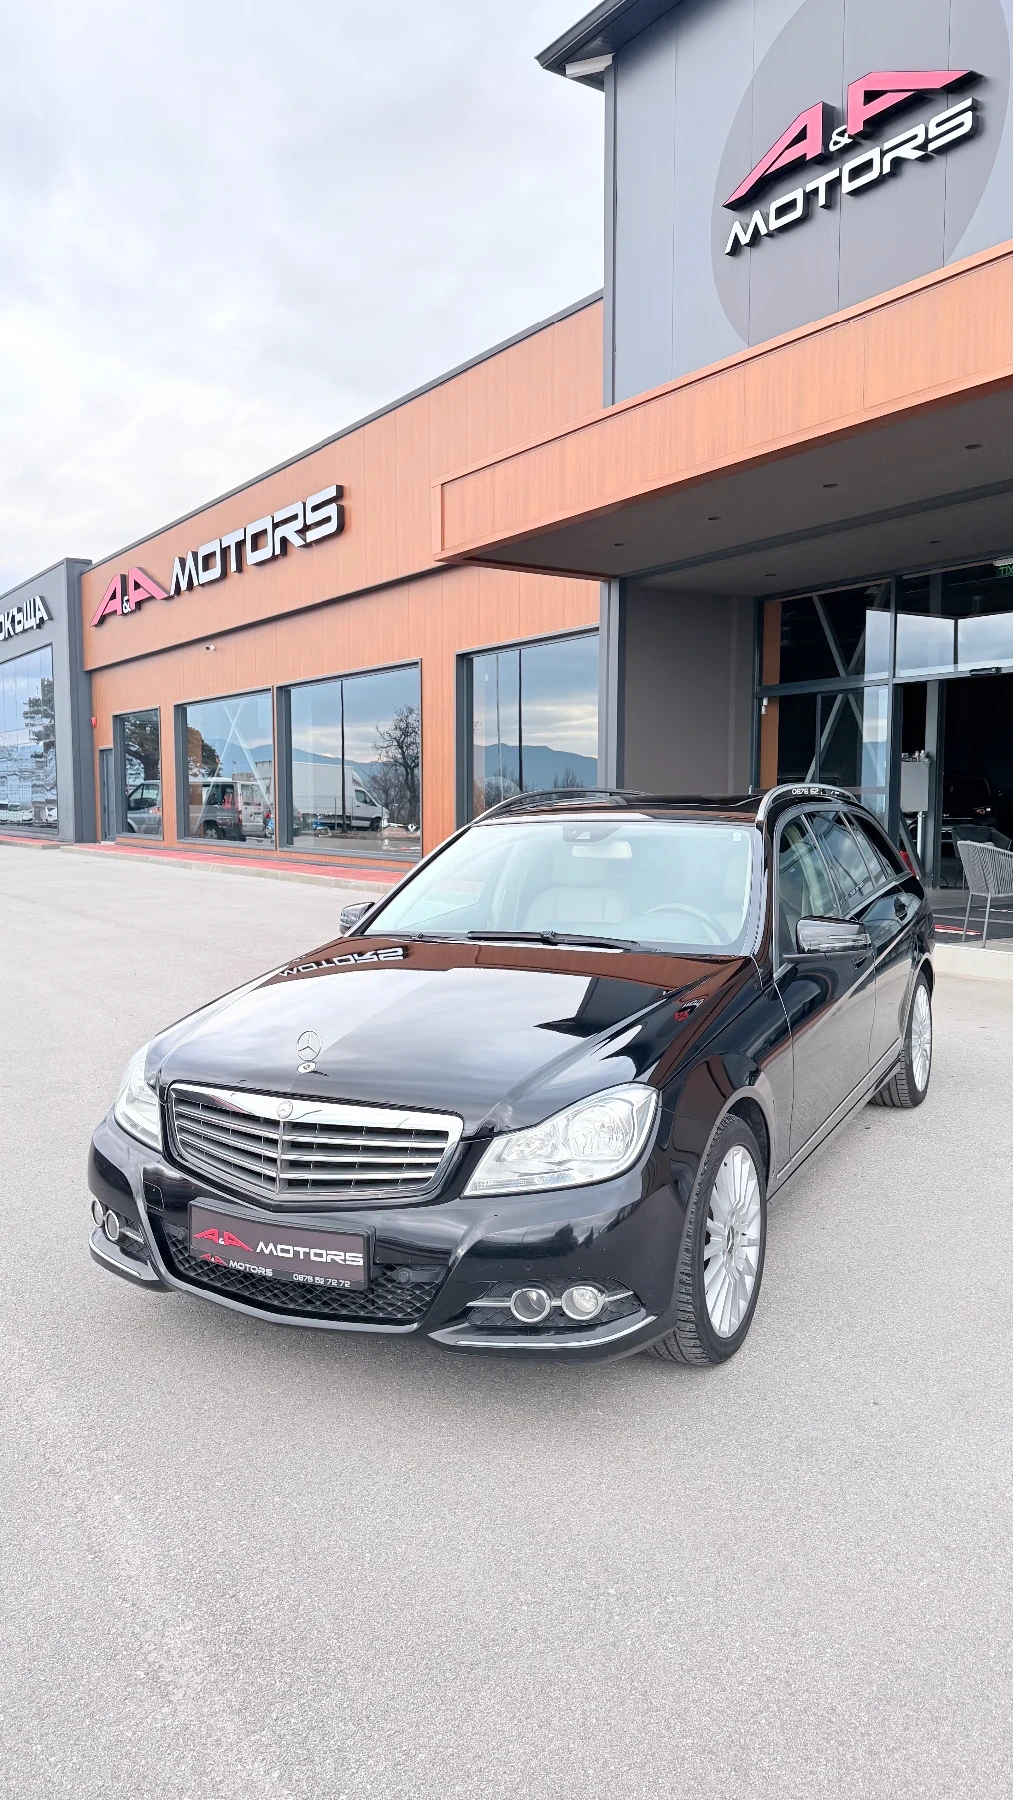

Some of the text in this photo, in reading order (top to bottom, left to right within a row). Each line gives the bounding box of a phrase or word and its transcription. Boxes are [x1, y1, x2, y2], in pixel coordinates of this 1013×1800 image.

[722, 70, 971, 206] A&A
[725, 97, 974, 254] MOTORS
[90, 484, 340, 626] A&A MOTORS
[193, 1228, 364, 1266] A&A MOTORS
[229, 1260, 273, 1277] MOTORS
[339, 1280, 351, 1288] 72
